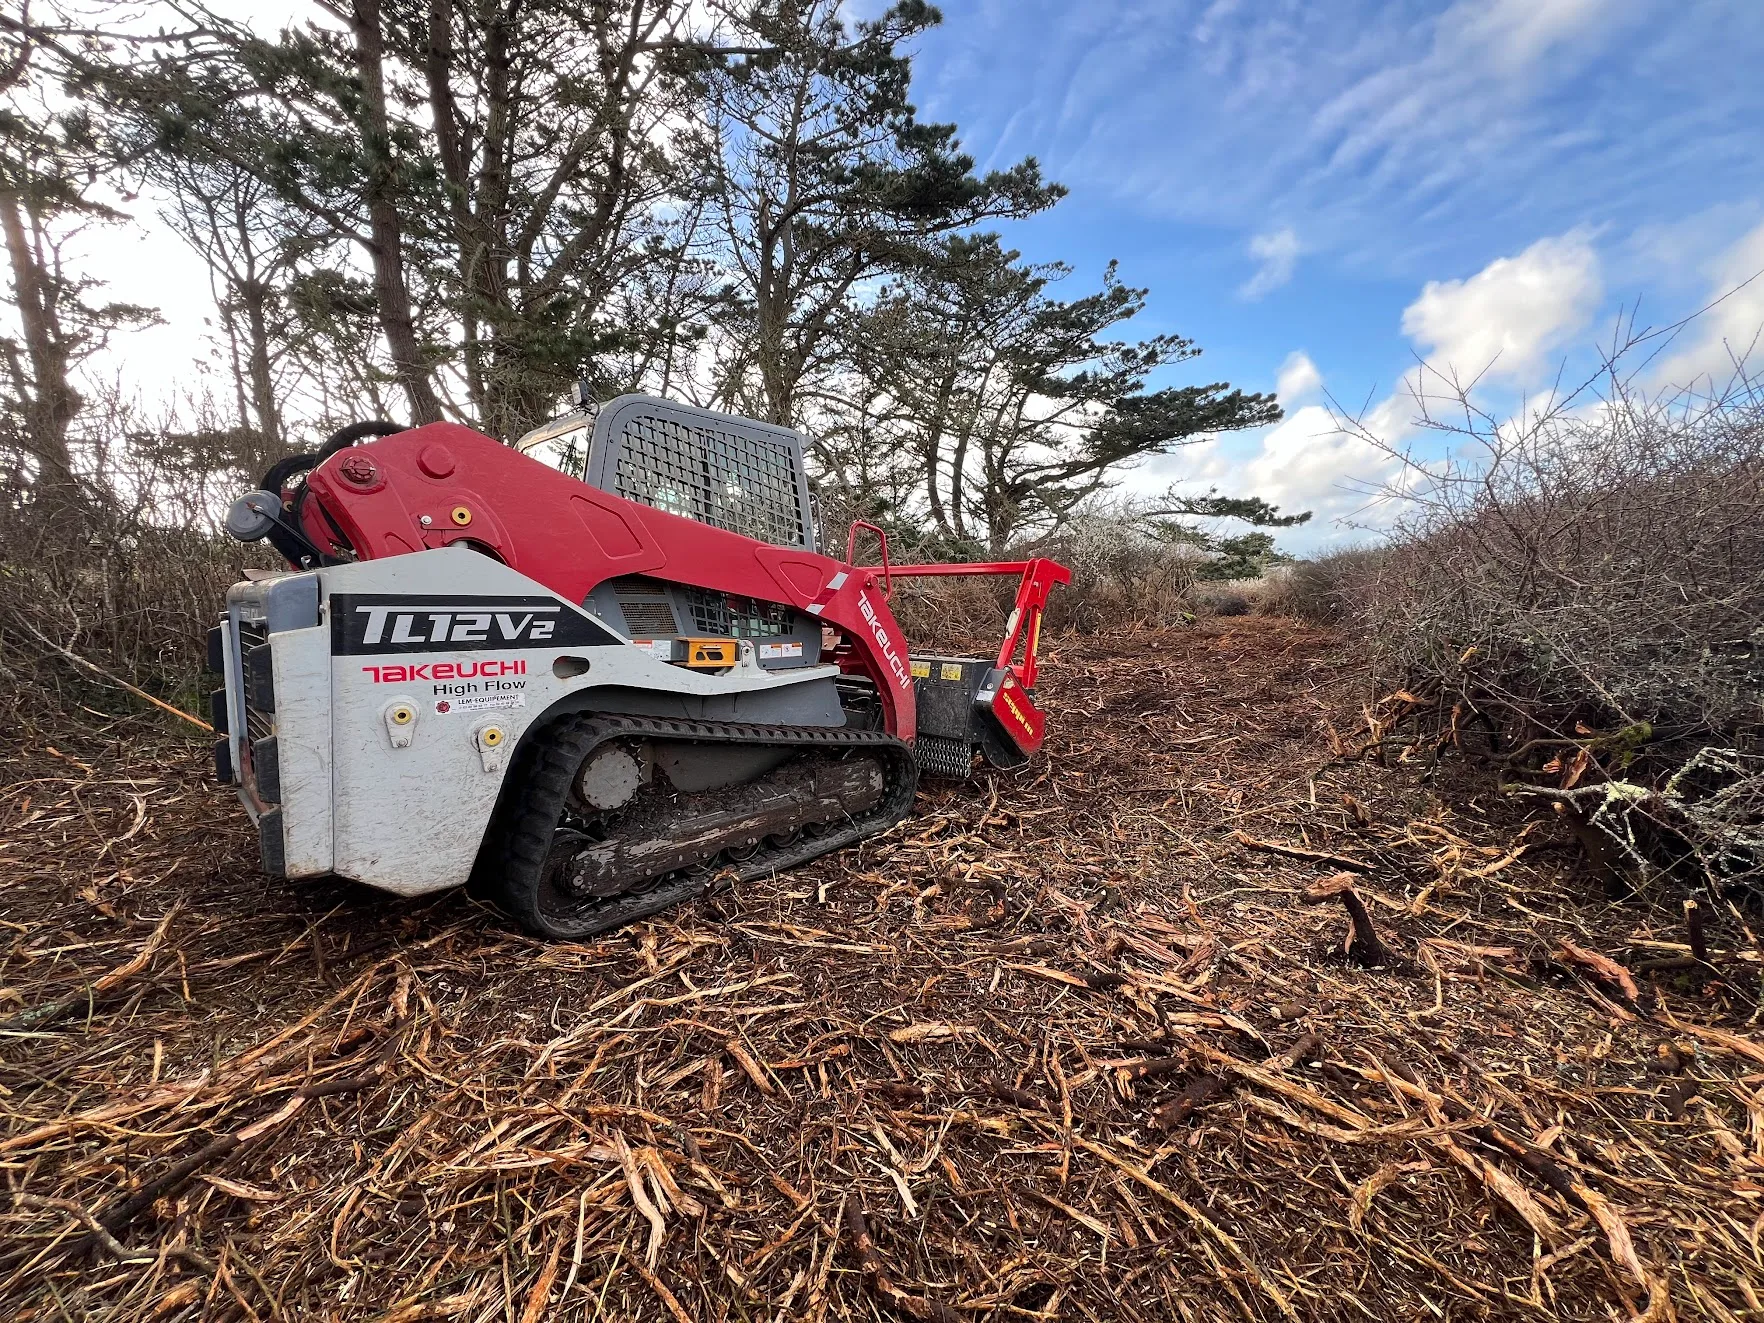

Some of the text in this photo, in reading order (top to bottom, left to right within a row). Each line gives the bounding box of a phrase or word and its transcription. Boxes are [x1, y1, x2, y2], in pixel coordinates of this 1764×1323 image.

[355, 606, 561, 644] TL12V2
[857, 590, 911, 689] TAKEUCHI
[362, 660, 526, 683] TAKEUCHI
[433, 680, 526, 696] High Flow
